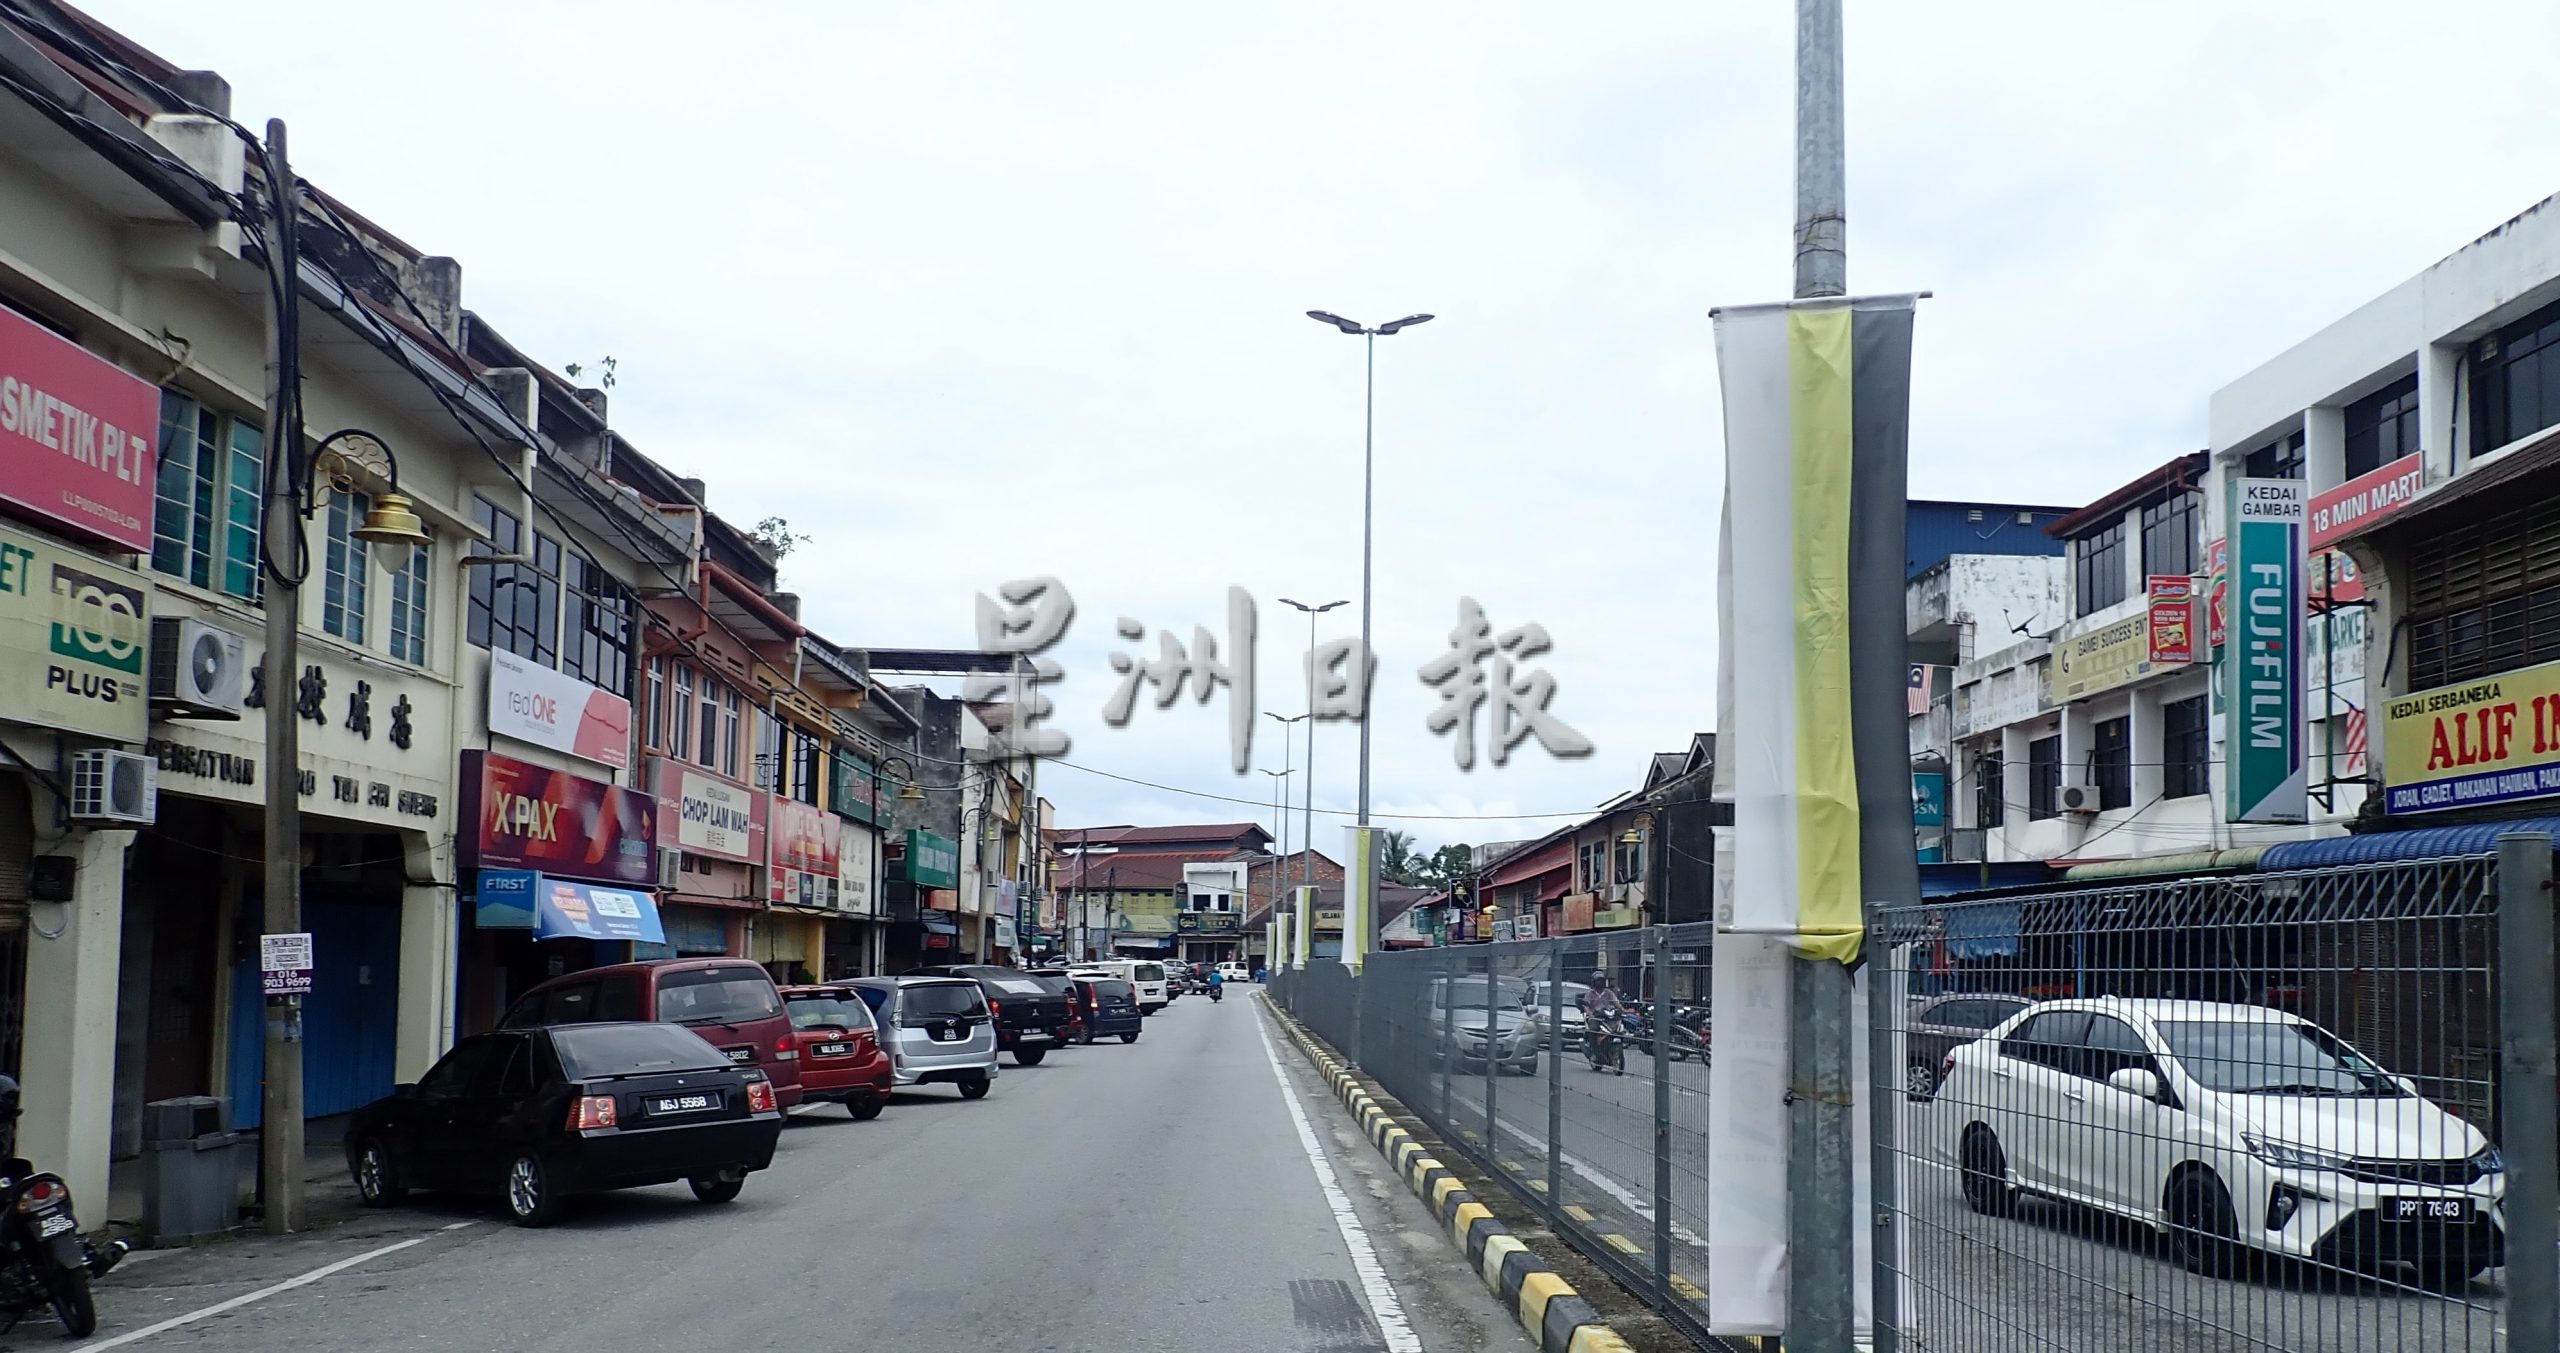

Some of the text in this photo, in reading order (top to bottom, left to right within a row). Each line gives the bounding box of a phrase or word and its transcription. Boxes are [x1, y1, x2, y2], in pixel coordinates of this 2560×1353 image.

[0, 376, 147, 486] SMETIK PLT
[2248, 486, 2296, 500] KEDAI
[2313, 470, 2419, 533] 18 MINI MART
[2242, 502, 2301, 517] GAMBAR
[56, 577, 138, 660] 100
[2101, 623, 2131, 648] SUCCESS
[2250, 563, 2282, 748] FUJIFILM
[47, 665, 119, 702] PLUS
[2391, 682, 2502, 721] KEDAI SERBANEKA
[2427, 702, 2518, 771] ALIF
[2454, 776, 2498, 800] MAKANAN
[682, 795, 709, 824] CHOP
[710, 803, 729, 830] LAM
[731, 809, 749, 835] WAH
[264, 978, 284, 988] 903
[277, 970, 298, 979] 016
[659, 1099, 678, 1111] AGJ
[2426, 1201, 2460, 1217] 7643
